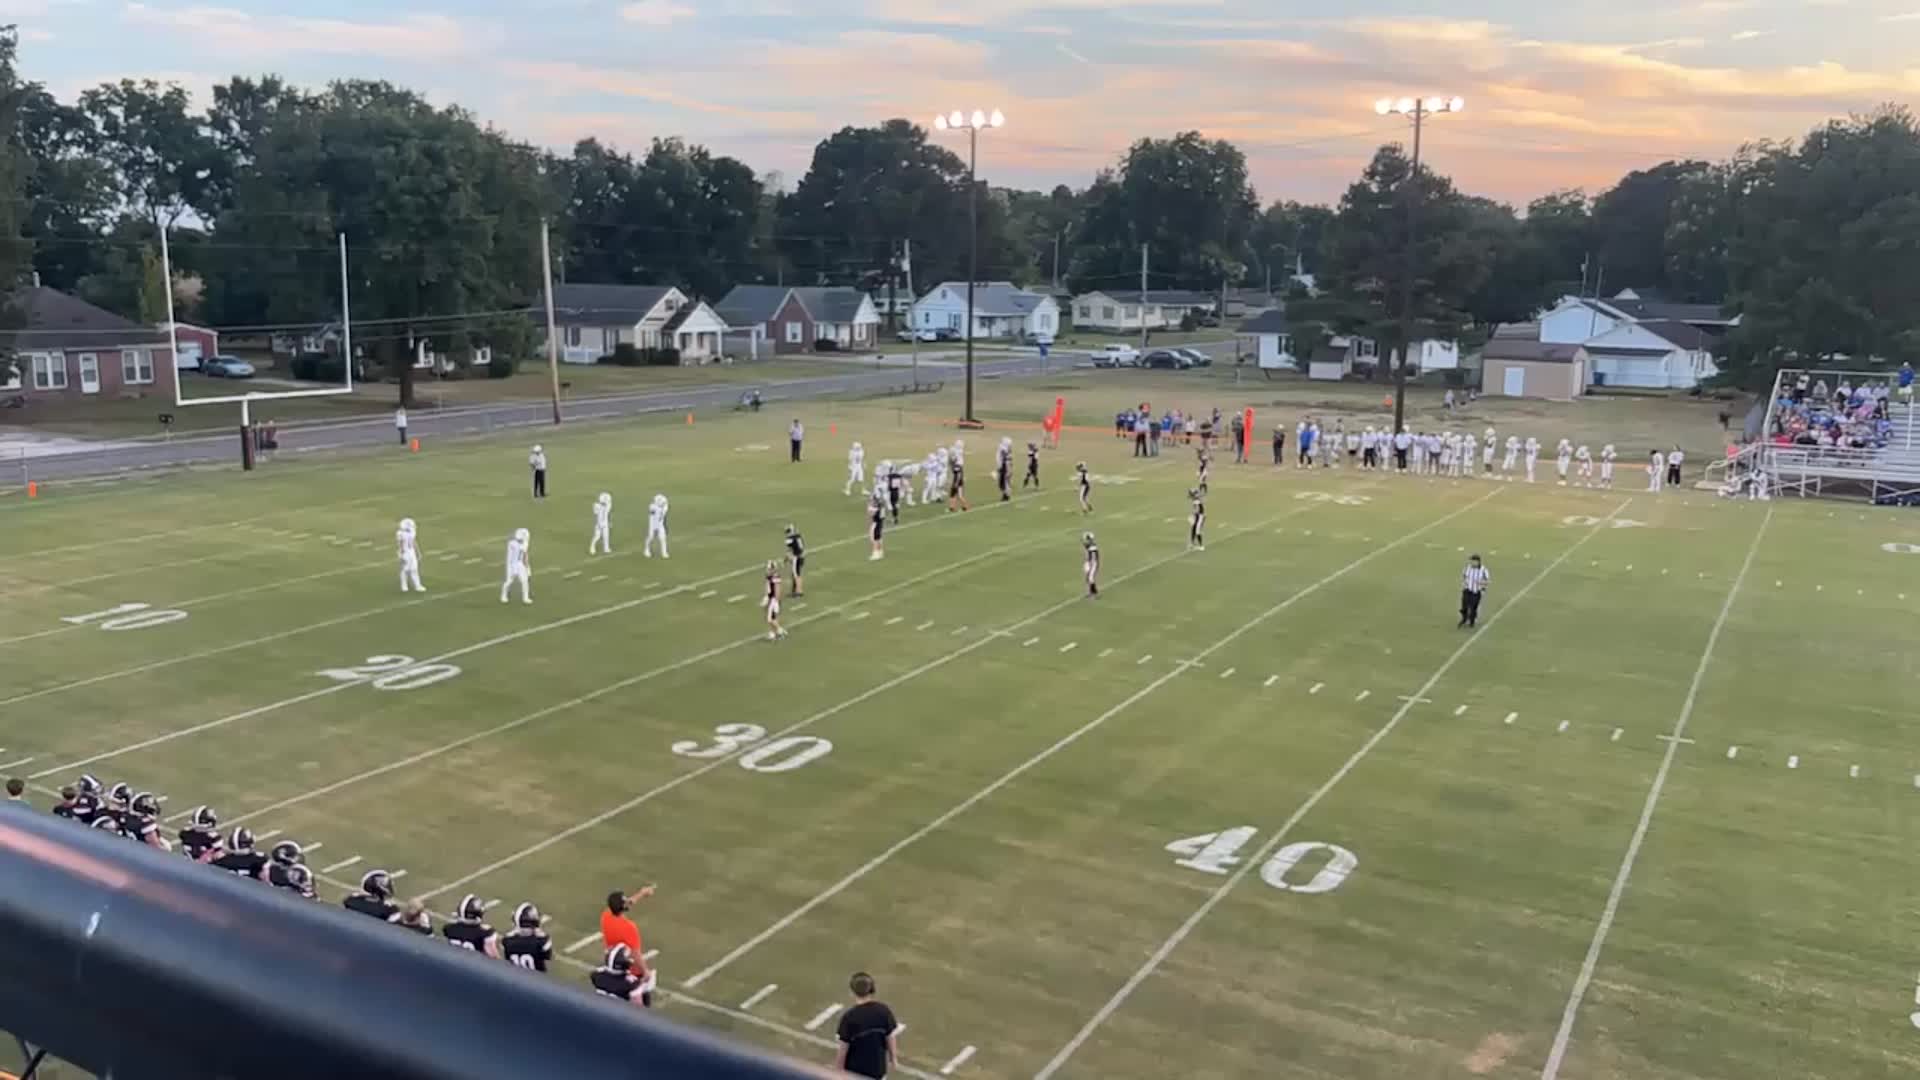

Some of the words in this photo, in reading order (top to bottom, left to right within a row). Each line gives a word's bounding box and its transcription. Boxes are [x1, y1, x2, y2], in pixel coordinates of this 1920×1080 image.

[60, 602, 188, 630] 10
[316, 655, 462, 690] 20
[671, 723, 834, 773] 30
[1164, 825, 1359, 893] 40
